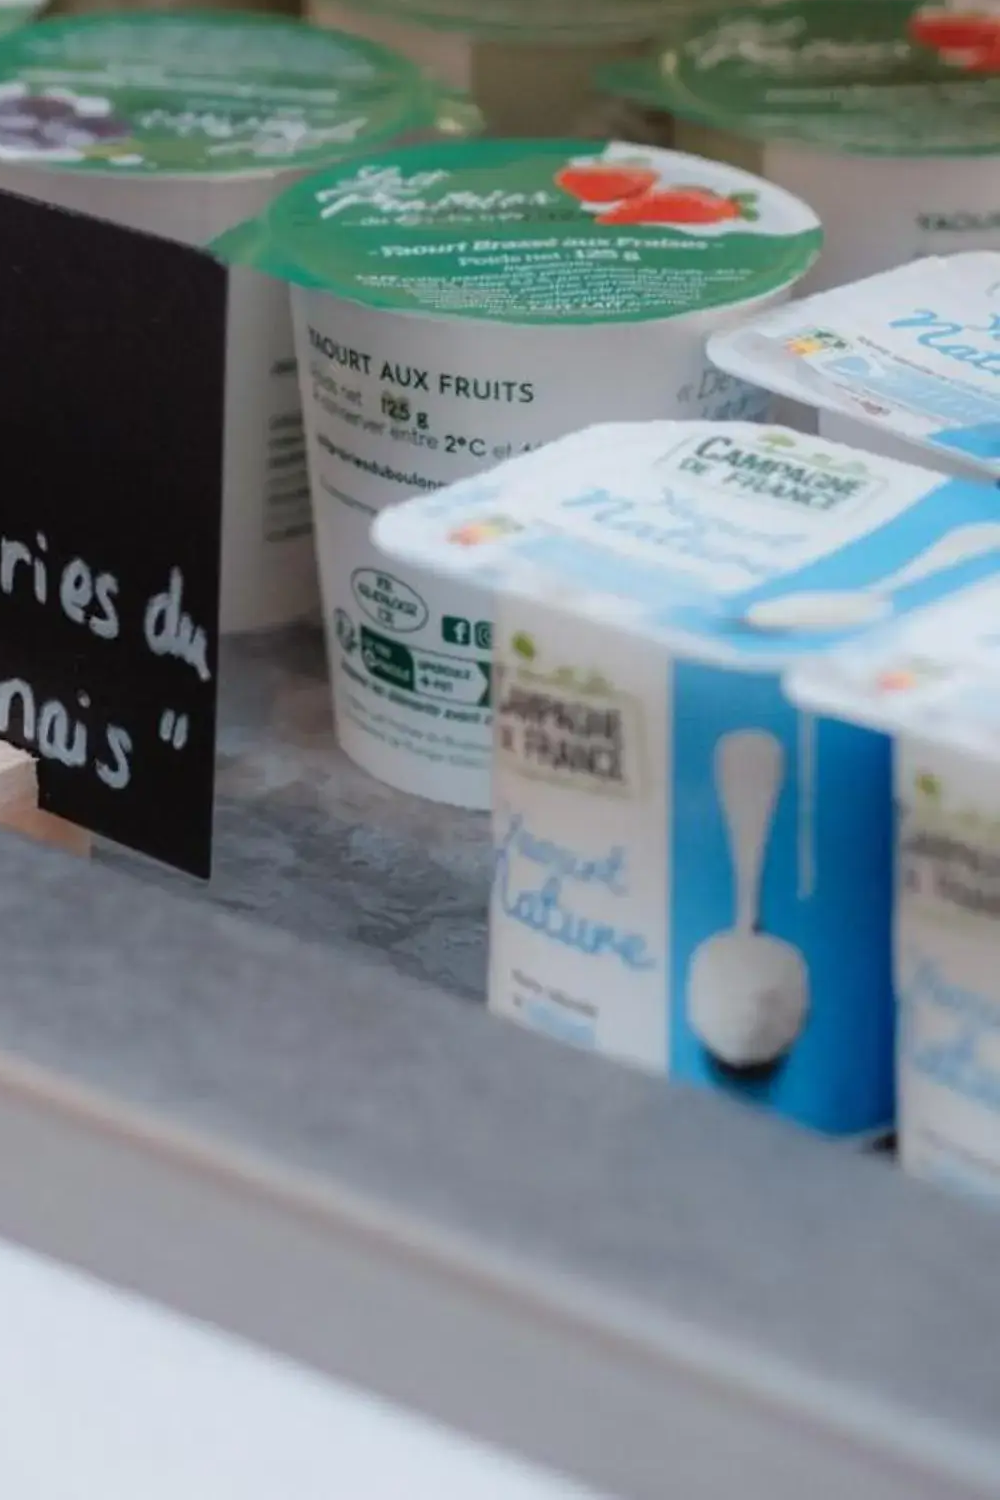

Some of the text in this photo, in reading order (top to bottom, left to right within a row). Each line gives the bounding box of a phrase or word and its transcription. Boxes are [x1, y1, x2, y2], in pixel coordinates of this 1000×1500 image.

[308, 325, 372, 376] YAOURT
[380, 360, 430, 392] AUX
[439, 373, 534, 403] FRUITS
[144, 565, 212, 682] du
